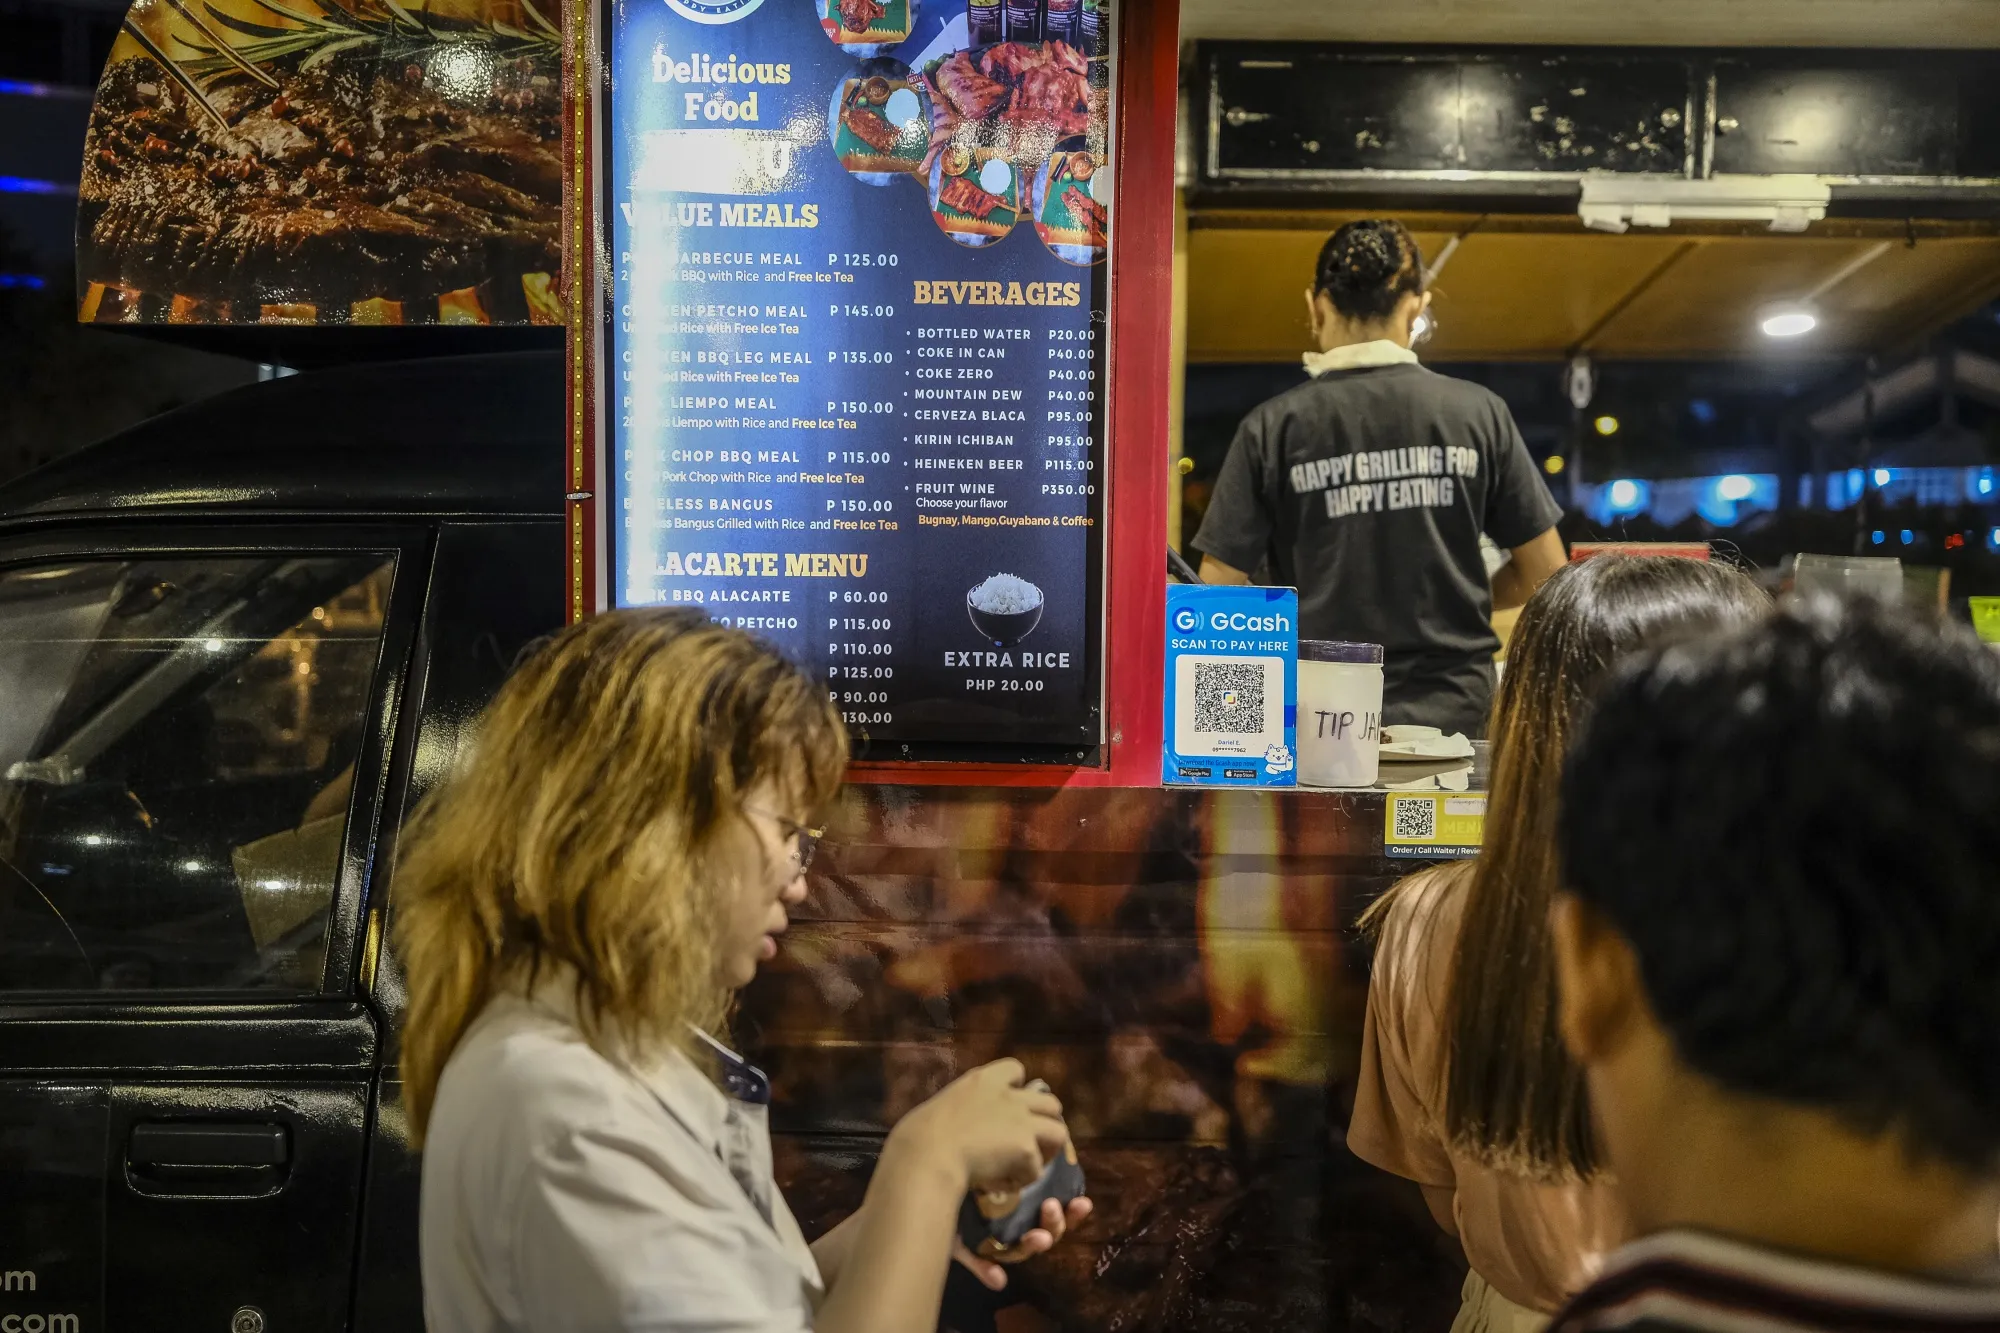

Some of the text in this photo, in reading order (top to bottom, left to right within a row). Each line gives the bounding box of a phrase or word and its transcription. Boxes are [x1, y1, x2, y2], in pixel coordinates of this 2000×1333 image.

[652, 53, 791, 84] Delicious
[684, 92, 759, 121] Food
[620, 203, 819, 228] VLUE MEALS
[671, 253, 753, 265] ARBECUE
[760, 253, 802, 265] MEAL
[829, 254, 898, 266] P 125.00
[681, 271, 706, 283] BBQ
[708, 270, 733, 282] with
[735, 271, 759, 282] Rice
[765, 271, 786, 283] and
[788, 271, 813, 283] Free
[815, 272, 831, 283] Ice
[833, 272, 854, 283] Tea
[913, 281, 1081, 306] BEVERAGES
[697, 305, 759, 317] PETCHO
[766, 305, 808, 317] MEAL
[830, 305, 894, 317] P 145.00
[679, 323, 704, 334] Rice
[706, 323, 732, 334] with
[734, 323, 759, 334] Free
[761, 323, 777, 334] Ice
[779, 323, 799, 334] Tea
[918, 328, 1031, 340] BOTTLED WATER
[1049, 330, 1095, 340] P20.00
[697, 351, 729, 365] BBQ
[735, 352, 764, 363] LEG
[770, 352, 812, 364] MEAL
[829, 352, 893, 364] P 135.00
[918, 348, 1005, 358] COKE IN CAN
[1049, 349, 1095, 359] P40.00
[680, 372, 704, 383] Rice
[706, 372, 732, 383] with
[734, 372, 759, 383] Free
[761, 372, 777, 383] Ice
[779, 372, 799, 383] Tea
[916, 369, 993, 379] COKE ZERO
[1049, 370, 1095, 380] P40.00
[915, 389, 1022, 400] MOUNTAIN DEW
[1049, 391, 1095, 401] P40.00
[671, 397, 729, 409] LIEMPO
[735, 398, 777, 410] MEAL
[827, 402, 894, 414] P 150.00
[914, 410, 1025, 421] CERVEZA BLACA
[1048, 412, 1093, 422] P95.00
[673, 417, 713, 431] Liempo
[715, 417, 739, 428] with
[742, 417, 766, 428] Rice
[768, 417, 789, 429] and
[792, 418, 816, 429] Free
[818, 418, 834, 429] Ice
[837, 418, 857, 429] Tea
[914, 435, 1013, 445] KIRIN ICHIBAN
[1048, 436, 1093, 446] P95.00
[671, 450, 714, 462] CHOP
[720, 451, 752, 464] BBQ
[758, 451, 800, 463] MEAL
[828, 452, 890, 464] P 115.00
[914, 459, 1023, 470] HEINEKEN BEER
[1045, 460, 1094, 470] P115.00
[1290, 445, 1479, 494] HAPPY GRILLING FOR
[662, 472, 687, 482] Pork
[689, 472, 718, 485] Chop
[721, 472, 745, 483] with
[748, 472, 771, 483] Rice
[776, 472, 797, 483] and
[800, 473, 824, 483] Free
[826, 473, 843, 483] Ice
[845, 473, 865, 484] Tea
[916, 484, 995, 494] FRUIT WINE
[1042, 485, 1095, 495] P350.00
[916, 498, 1008, 510] Choose your flavor
[1324, 477, 1454, 519] HAPPY EATING
[624, 498, 773, 511] BELESS BANGUS
[827, 500, 892, 512] P 150.00
[674, 518, 714, 531] Bangus
[717, 518, 752, 529] Grilled
[754, 518, 779, 529] with
[782, 519, 805, 529] Rice
[810, 519, 830, 530] and
[833, 519, 858, 530] Free
[860, 519, 876, 530] Ice
[878, 520, 898, 530] Tea
[919, 515, 960, 527] Bugnay,
[1053, 517, 1059, 525] &
[1061, 516, 1094, 526] Coffee
[627, 552, 868, 577] LACARTE MENU
[672, 590, 704, 604] BBQ
[710, 590, 791, 602] ALACARTE
[830, 591, 888, 603] P 60.00
[737, 617, 798, 629] PETCHO
[830, 619, 891, 630] P 115.00
[1211, 612, 1289, 632] GCash
[830, 644, 892, 655] P 110.00
[1171, 639, 1289, 651] SCAN TO PAY HERE
[944, 652, 1070, 668] EXTRA RICE
[830, 667, 893, 679] P 125.00
[966, 679, 1044, 691] PHP 20.00
[829, 692, 887, 703] P 90.00
[842, 712, 892, 724] 130.00
[1315, 710, 1355, 740] TIP
